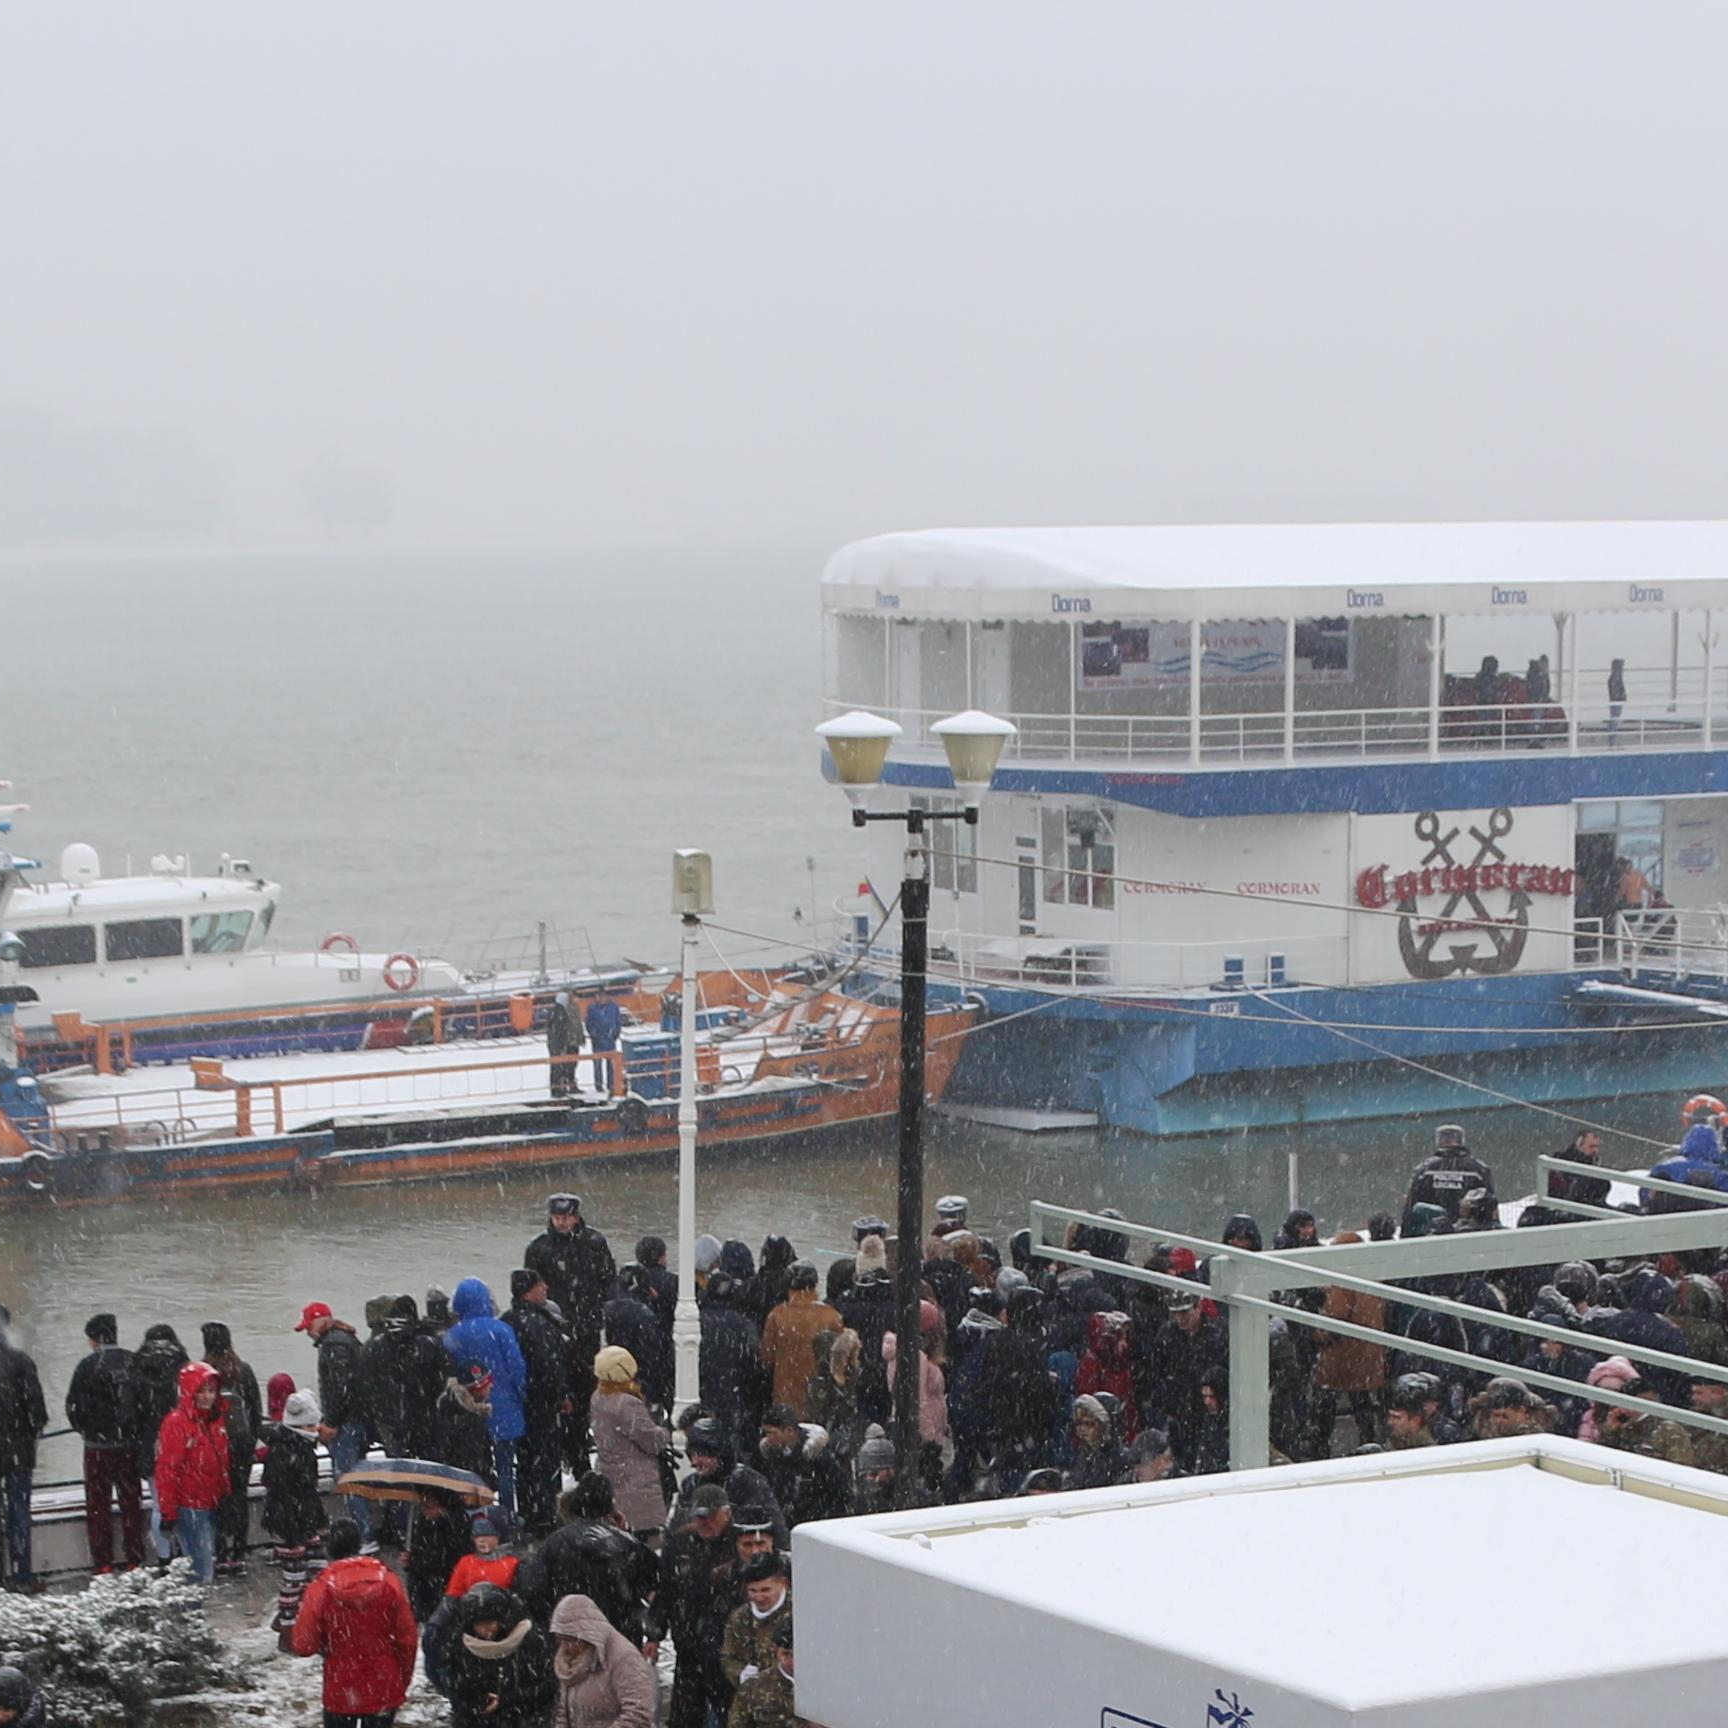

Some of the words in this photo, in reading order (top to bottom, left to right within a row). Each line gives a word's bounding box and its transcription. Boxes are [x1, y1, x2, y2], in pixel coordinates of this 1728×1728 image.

[1051, 593, 1092, 613] Dorna
[1346, 588, 1384, 608] Dorna
[1491, 586, 1528, 605] Dorna
[1629, 584, 1664, 603] Dorna
[1235, 882, 1321, 895] CORMORAN
